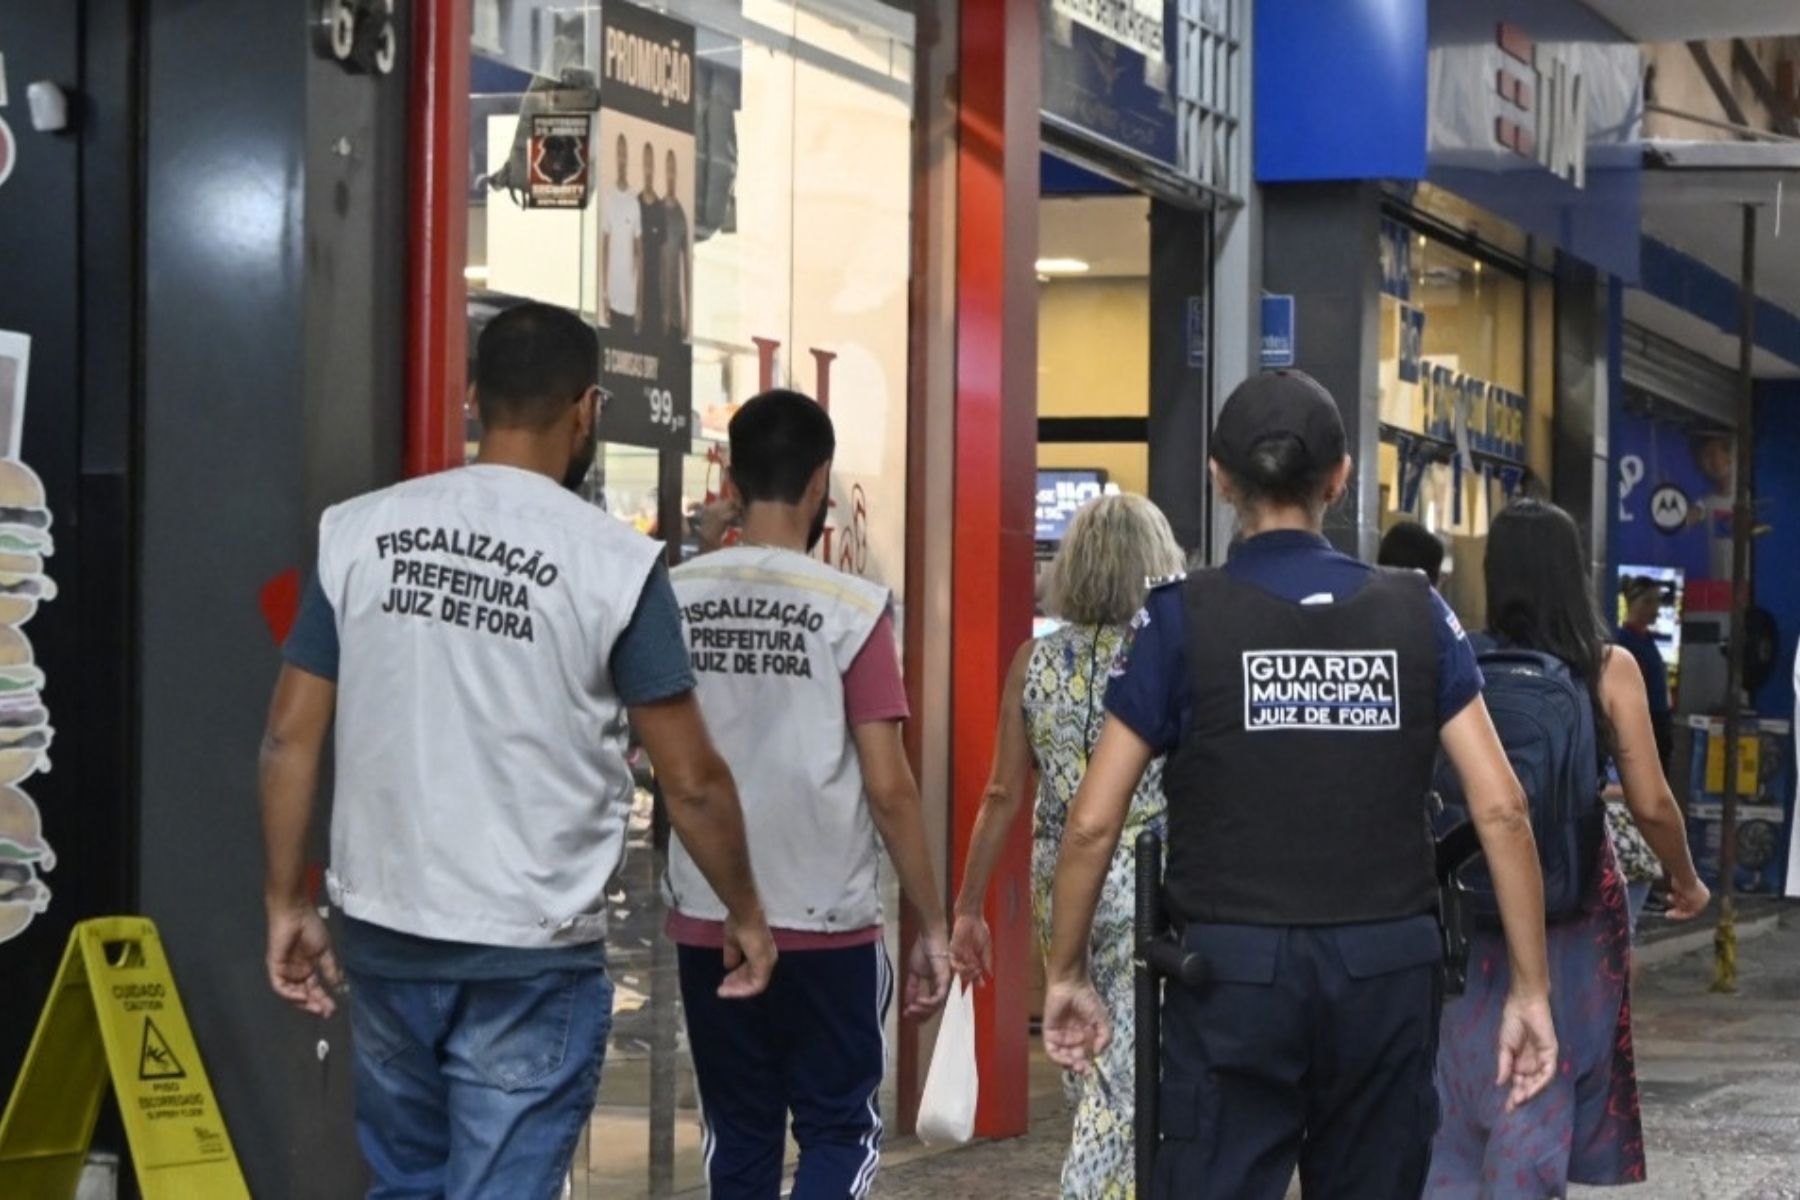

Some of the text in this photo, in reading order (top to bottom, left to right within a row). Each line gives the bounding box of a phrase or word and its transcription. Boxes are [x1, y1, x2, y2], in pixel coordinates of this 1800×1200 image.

[605, 25, 690, 108] PROMOÇÃO
[376, 527, 558, 587] FISCALIZAÇÃO
[392, 559, 529, 611] PREFEITURA
[382, 588, 534, 643] JUIZ DE FORA
[680, 597, 824, 633] ISCALIZAÇÃO
[690, 627, 806, 653] PREFEITURA
[734, 653, 757, 675] DE
[763, 653, 812, 680] FORA
[1250, 656, 1390, 681] GUARDA
[1252, 682, 1392, 702] MUNICIPAL
[1253, 707, 1393, 725] JUIZ DE FORA
[112, 983, 166, 998] CUIDADO
